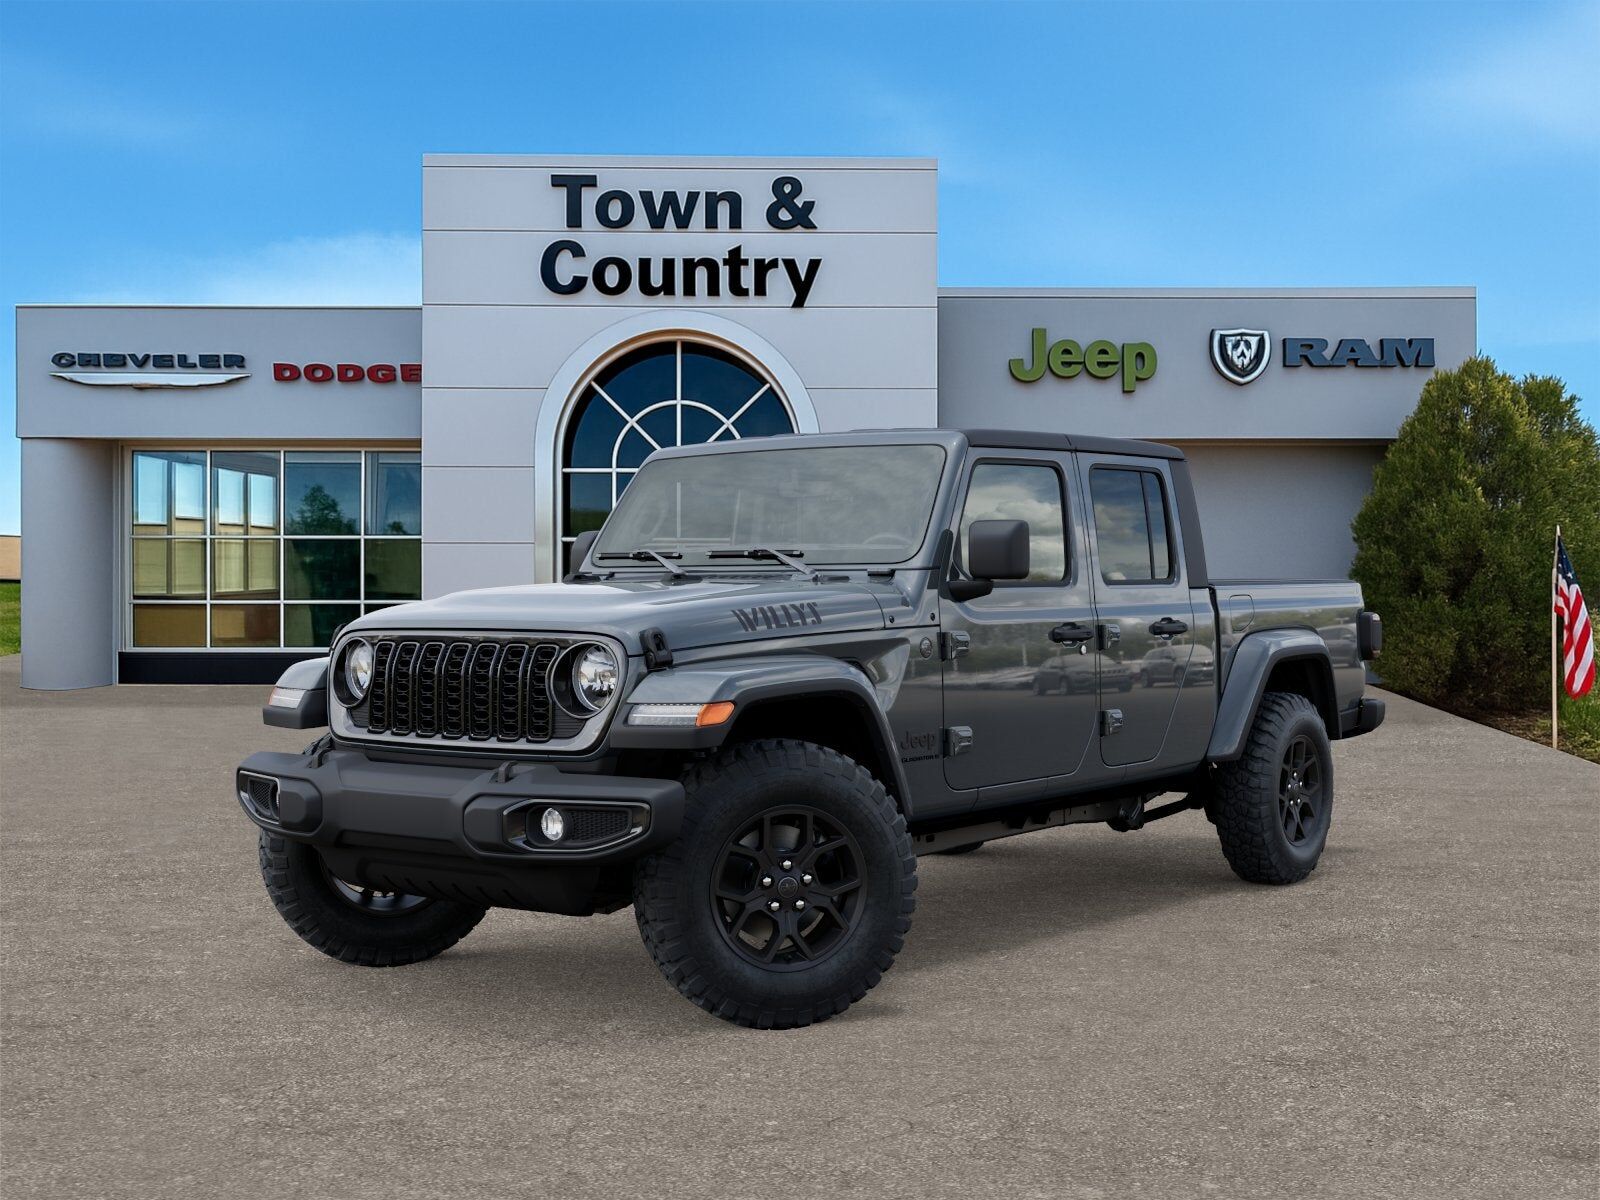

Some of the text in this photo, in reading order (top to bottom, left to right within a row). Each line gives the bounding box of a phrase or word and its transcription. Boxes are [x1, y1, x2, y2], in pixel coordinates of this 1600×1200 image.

[550, 174, 818, 230] Town &
[540, 239, 822, 308] Country
[1008, 327, 1157, 393] Jeep
[1283, 337, 1435, 368] RAM
[273, 363, 421, 383] DODGE
[731, 602, 822, 632] WILLYS
[900, 731, 935, 750] Jeep
